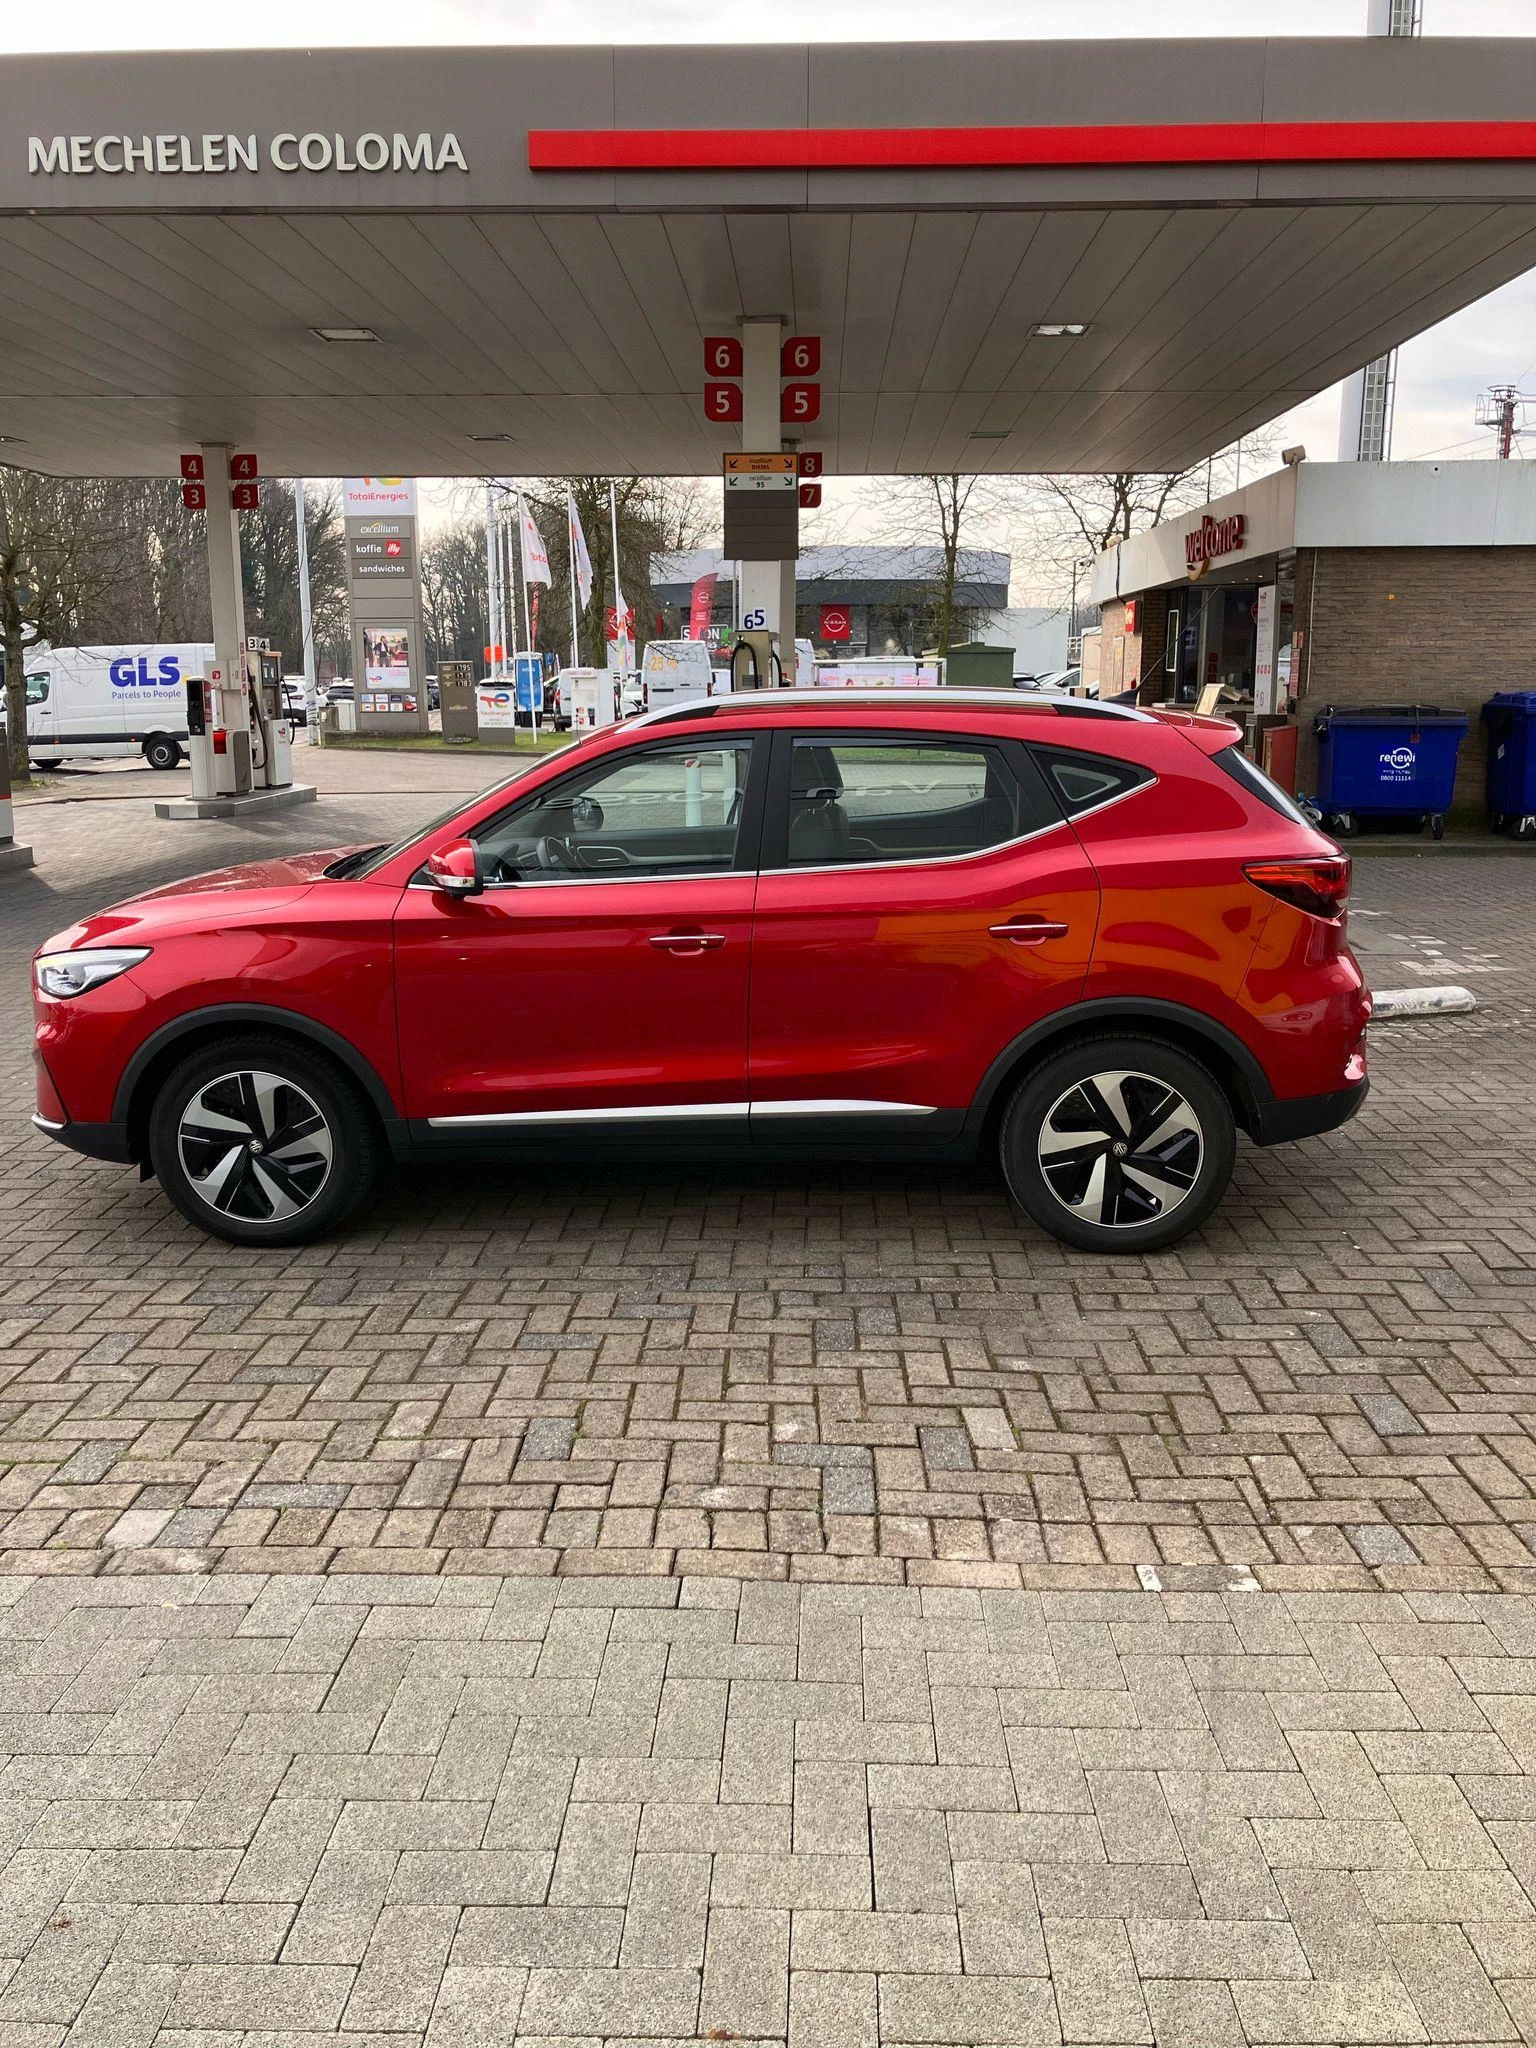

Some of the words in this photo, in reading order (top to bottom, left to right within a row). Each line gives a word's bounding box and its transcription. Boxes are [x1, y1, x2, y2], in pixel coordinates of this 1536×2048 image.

[28, 134, 258, 174] MECHELEN
[270, 132, 469, 173] COLOMA
[715, 345, 730, 368] 6
[794, 344, 810, 368] 6
[715, 390, 730, 414] 5
[794, 391, 808, 414] 5
[187, 459, 198, 475] 4
[239, 459, 250, 475] 4
[804, 457, 816, 473] 8
[190, 489, 200, 504] 3
[242, 489, 251, 504] 3
[349, 492, 409, 502] TotalEnergies
[805, 488, 815, 504] 7
[360, 524, 399, 534] excellium
[1185, 515, 1244, 562] welcome
[356, 544, 382, 553] koffie
[359, 564, 405, 573] sandwiches
[744, 614, 754, 630] 6
[754, 609, 765, 626] 5
[249, 639, 256, 649] 3
[259, 640, 267, 650] 4
[109, 656, 181, 688] GLS
[111, 692, 141, 700] Parcels
[142, 691, 152, 699] to
[153, 690, 181, 699] People
[1379, 752, 1416, 763] renewi
